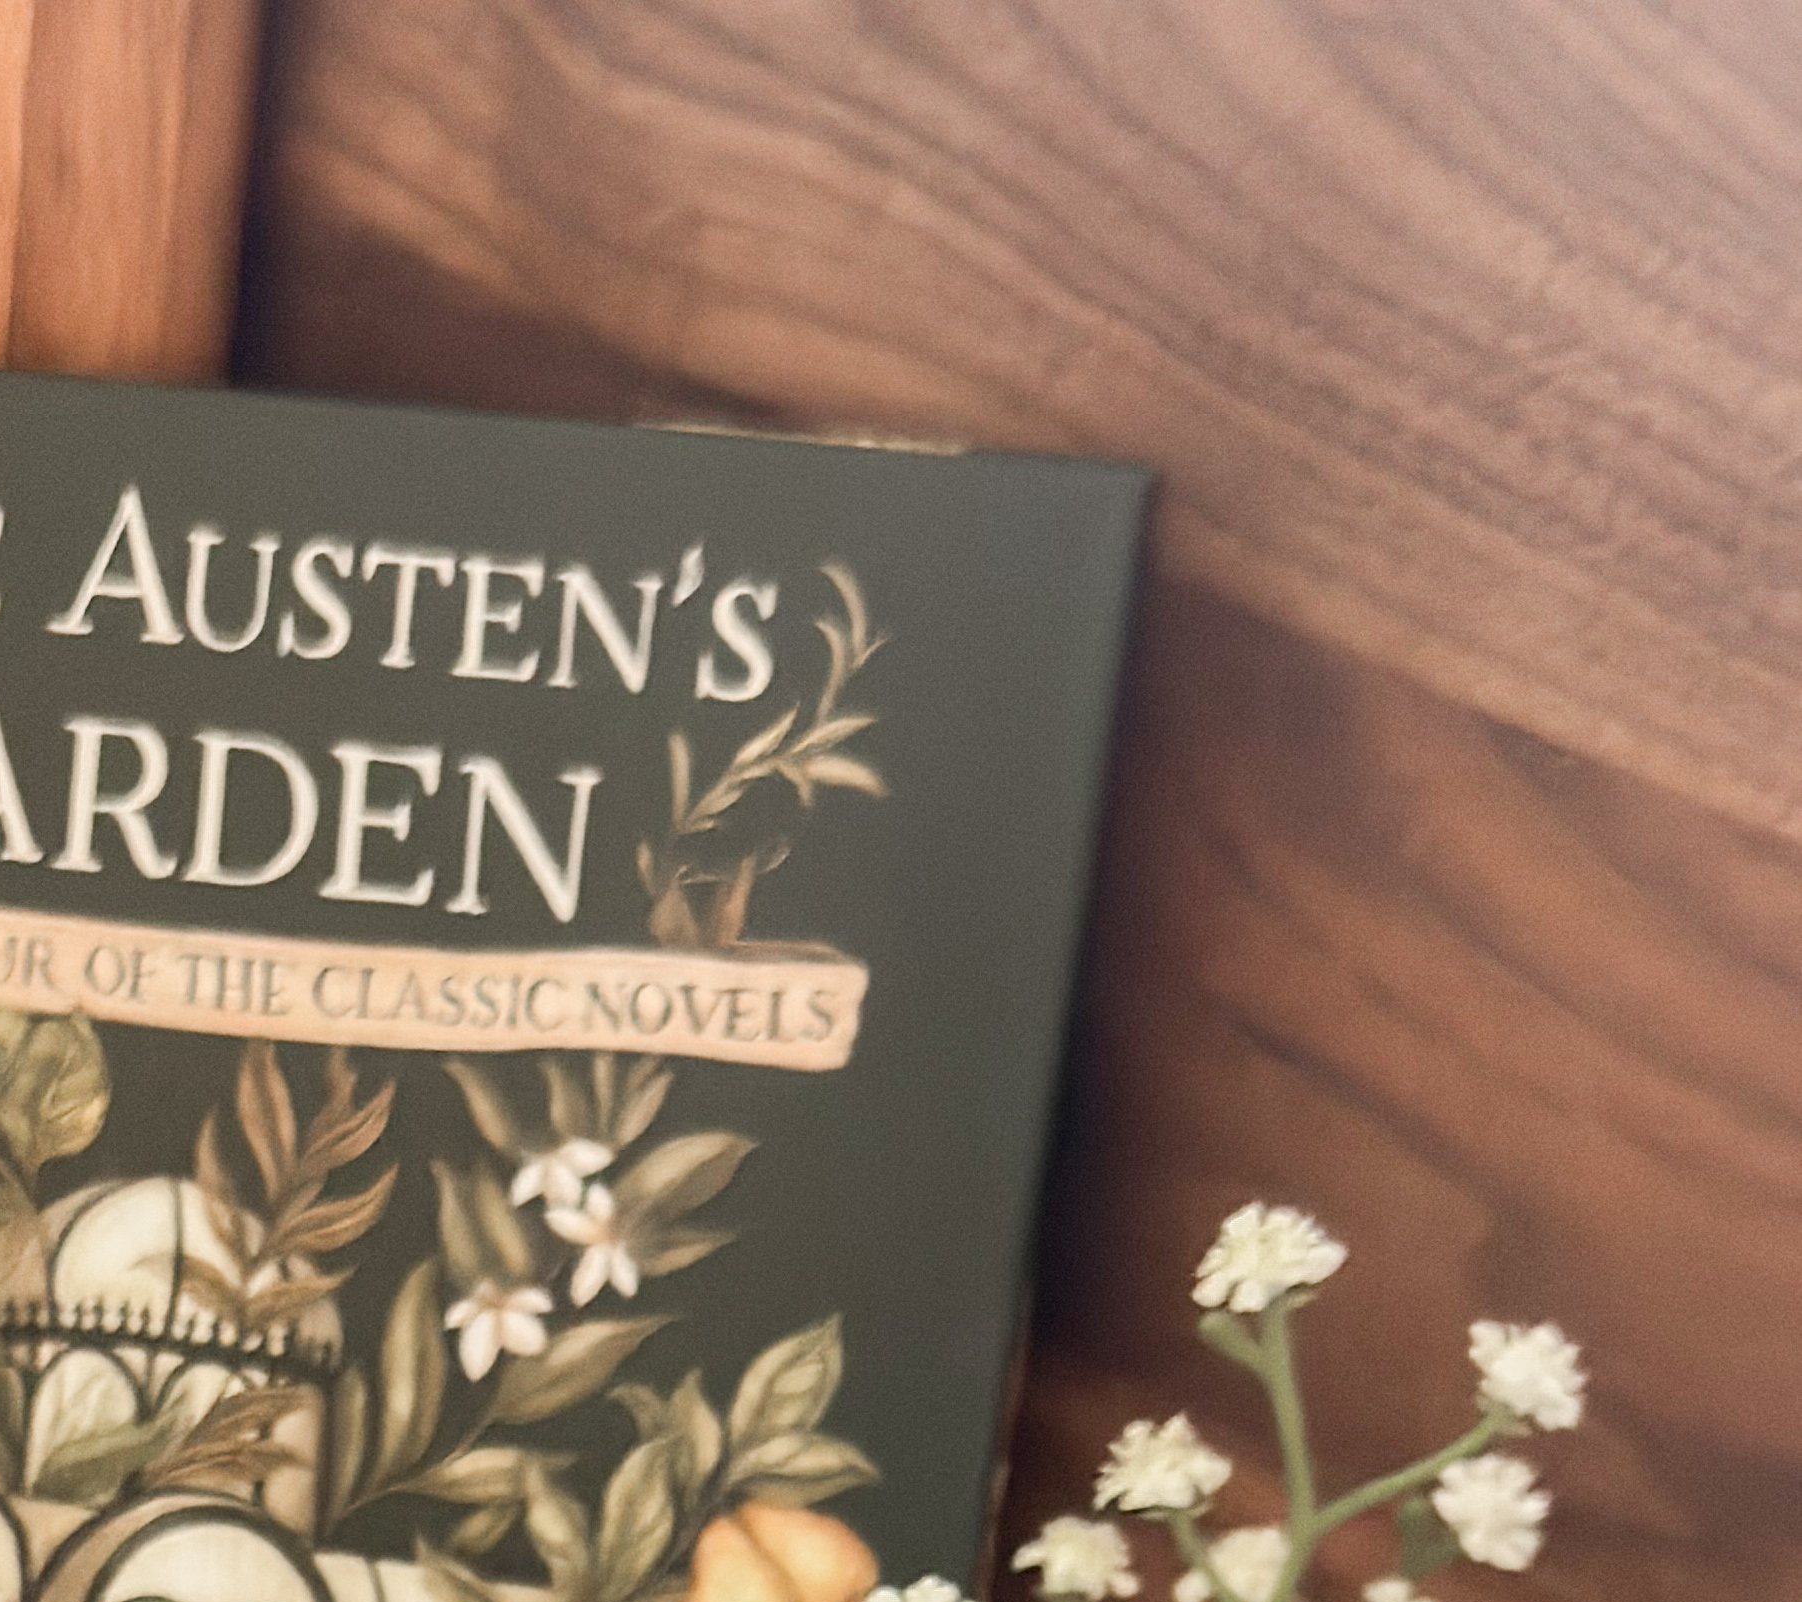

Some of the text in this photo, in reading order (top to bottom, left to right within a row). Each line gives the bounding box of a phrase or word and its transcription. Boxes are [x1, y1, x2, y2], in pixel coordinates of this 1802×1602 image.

[48, 484, 780, 704] AUSTEN'S
[84, 948, 160, 1000] OF
[180, 951, 288, 1018] THE
[310, 965, 569, 1034] CLASSIC
[583, 981, 838, 1044] NOVELS
